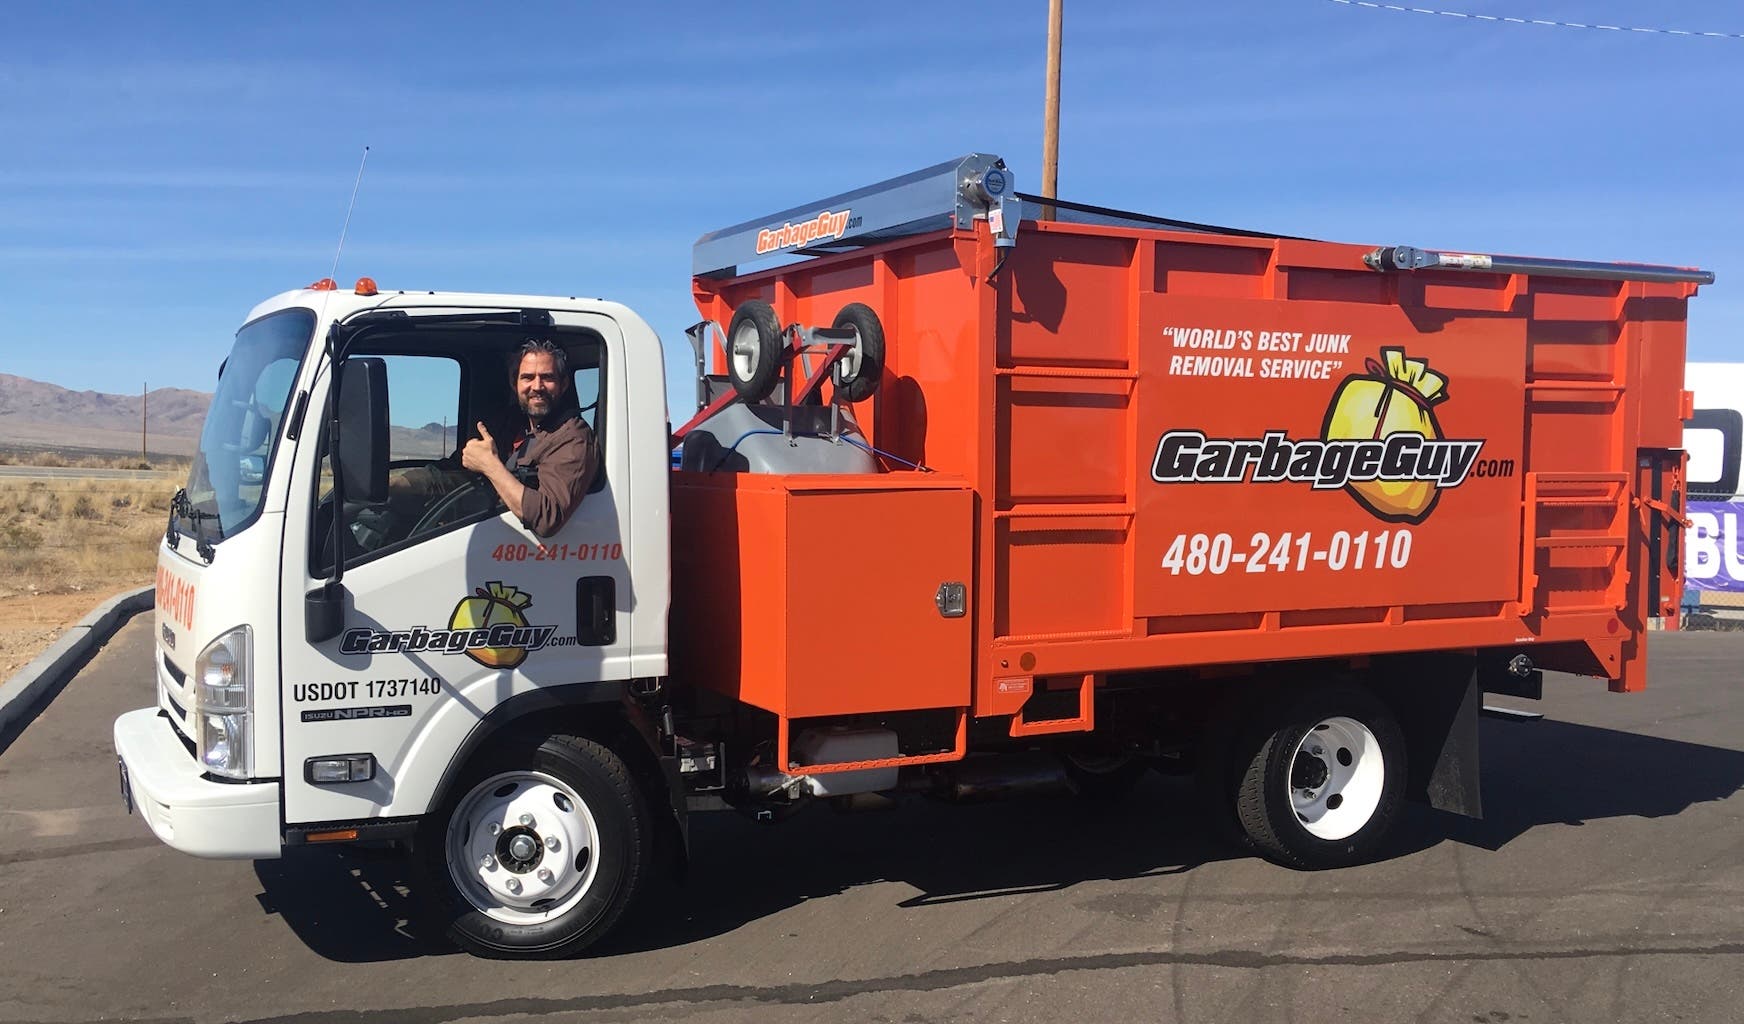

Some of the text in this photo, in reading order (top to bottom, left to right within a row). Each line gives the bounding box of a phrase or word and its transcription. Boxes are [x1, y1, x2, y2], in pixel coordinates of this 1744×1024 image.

[1257, 331, 1303, 352] BEST
[1305, 333, 1352, 353] JUNK
[1169, 355, 1255, 378] REMOVAL
[492, 543, 622, 562] 480-241-0110
[1162, 530, 1412, 576] 480-241-0110
[293, 678, 441, 702] USDOT 1737140
[304, 712, 333, 720] ISUZU
